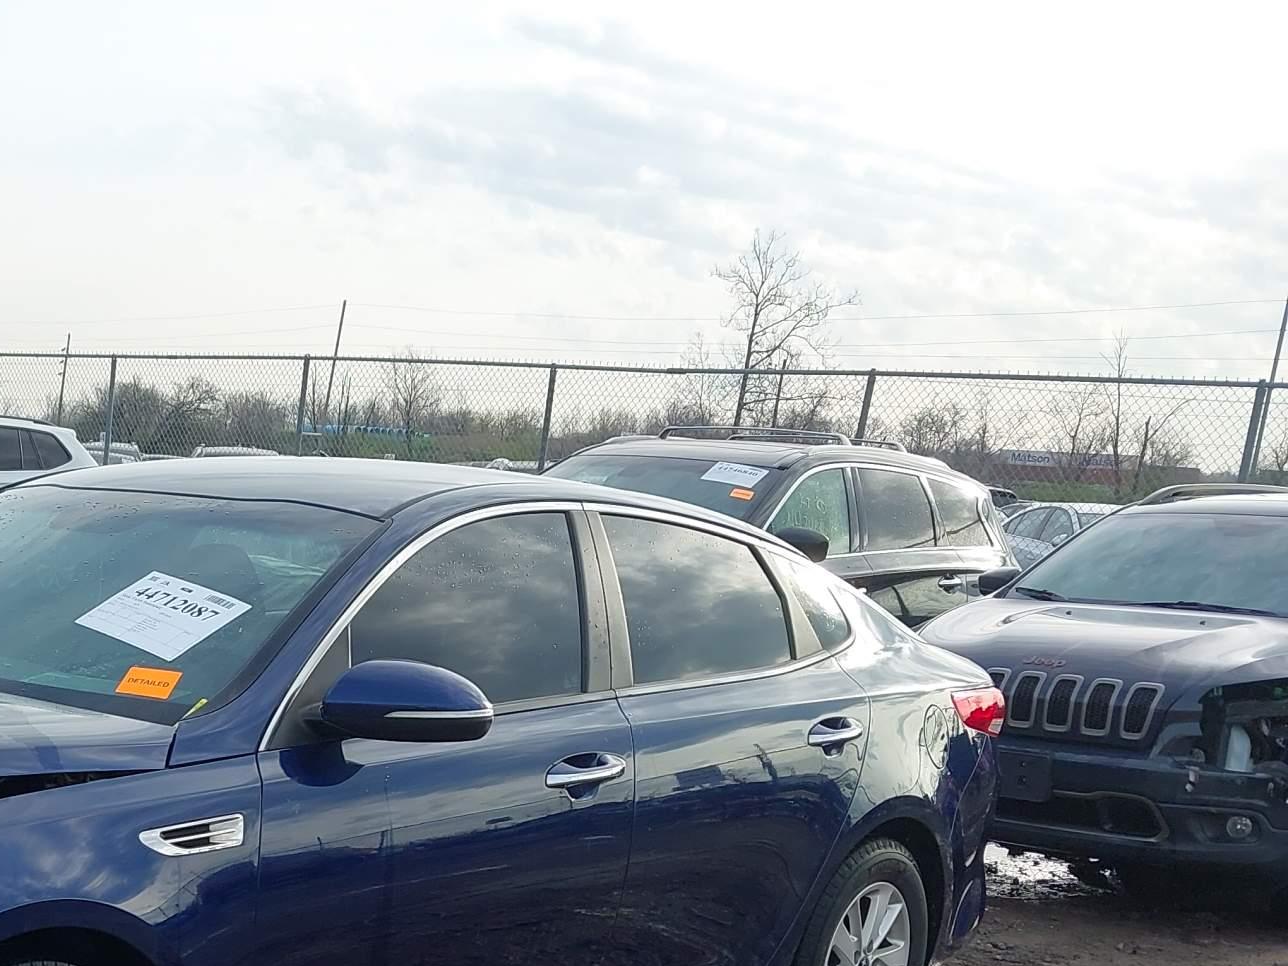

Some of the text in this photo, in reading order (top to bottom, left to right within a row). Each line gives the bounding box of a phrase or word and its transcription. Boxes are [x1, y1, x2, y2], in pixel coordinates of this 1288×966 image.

[1010, 452, 1050, 464] Matson
[134, 586, 221, 621] 44712087
[1022, 655, 1067, 669] Jeep
[127, 676, 170, 688] DETAILED
